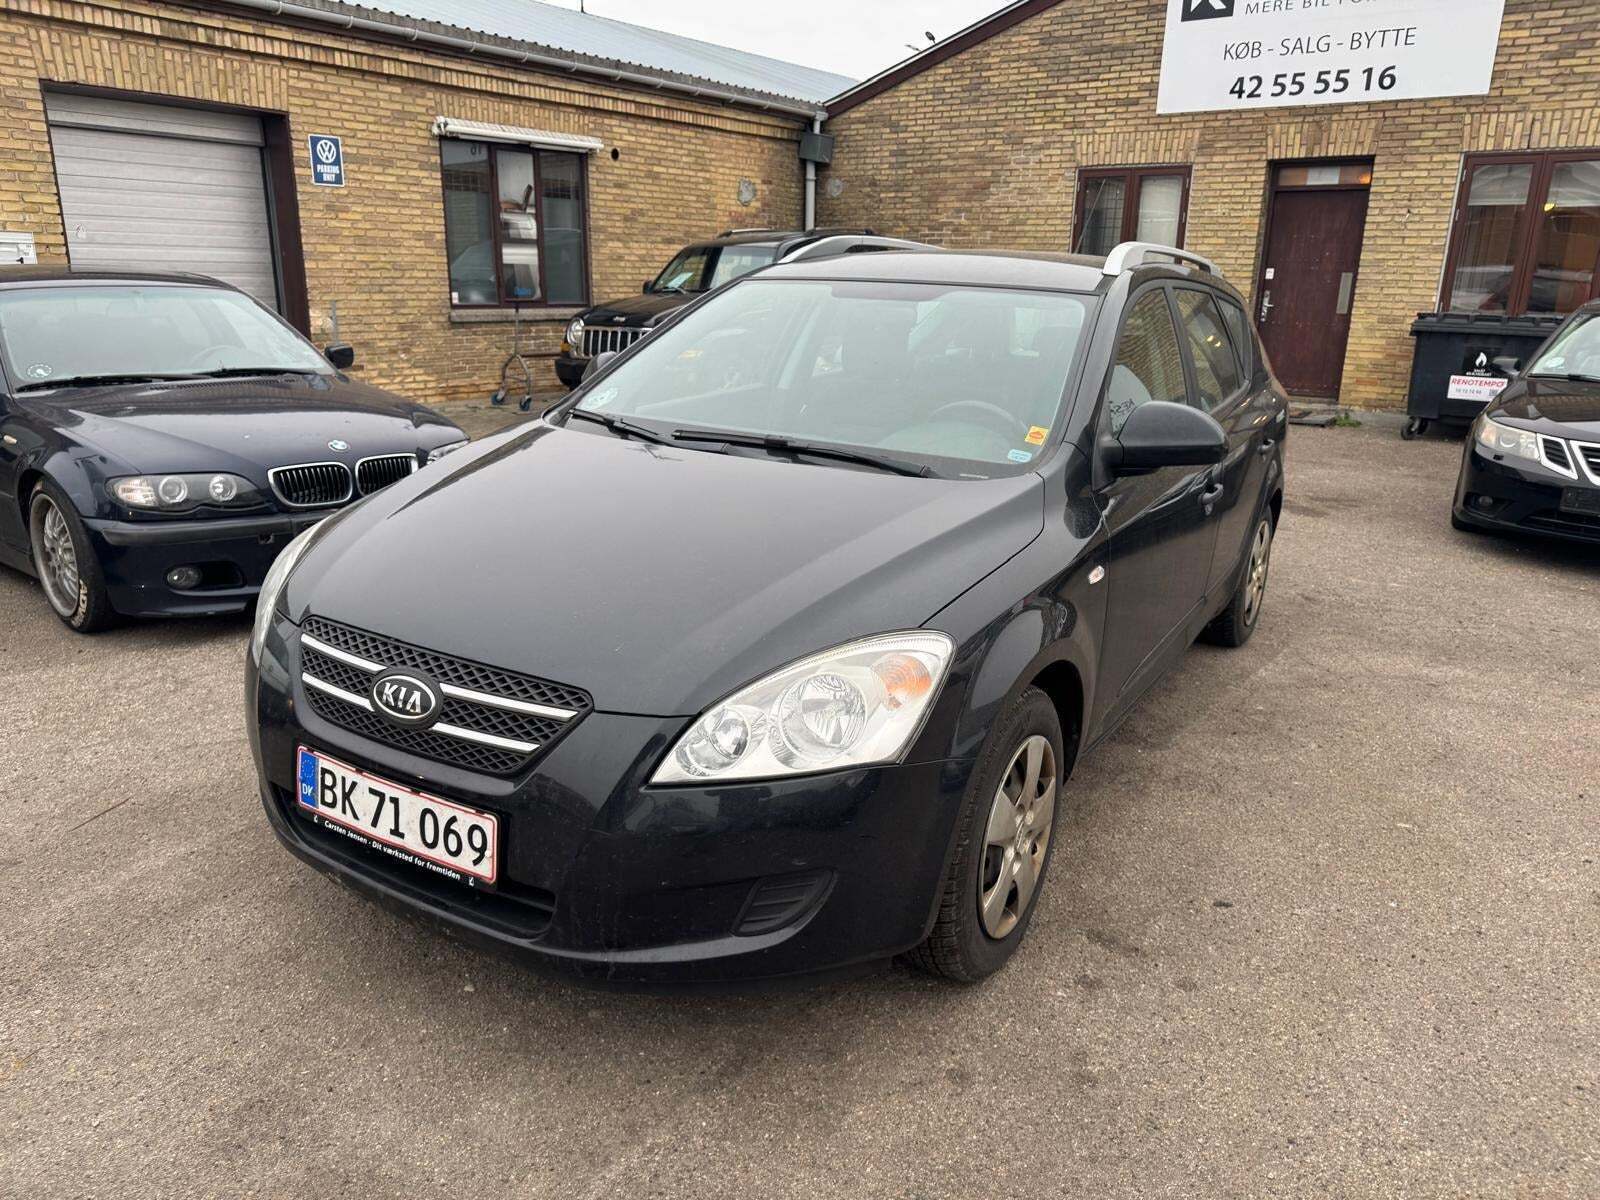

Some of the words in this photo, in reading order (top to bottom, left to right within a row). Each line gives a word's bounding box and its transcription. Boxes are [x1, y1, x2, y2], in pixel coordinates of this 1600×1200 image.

[1245, 0, 1294, 15] MERE
[1223, 40, 1263, 61] KØB
[1279, 34, 1331, 56] SALG
[1349, 26, 1417, 50] BYTTE
[1229, 75, 1263, 99] 42
[1270, 71, 1306, 97] 55
[1313, 69, 1350, 95] 55
[1361, 65, 1397, 91] 16
[382, 682, 422, 713] KIA
[302, 782, 314, 796] DK
[320, 767, 359, 821] BK
[368, 788, 405, 840] 71
[419, 807, 488, 866] 069
[324, 820, 347, 835] Carsten
[347, 830, 368, 845] Jensen
[371, 840, 382, 851] Dit
[383, 845, 413, 863] værksted
[414, 855, 425, 867] for
[426, 861, 461, 881] fremtiden
